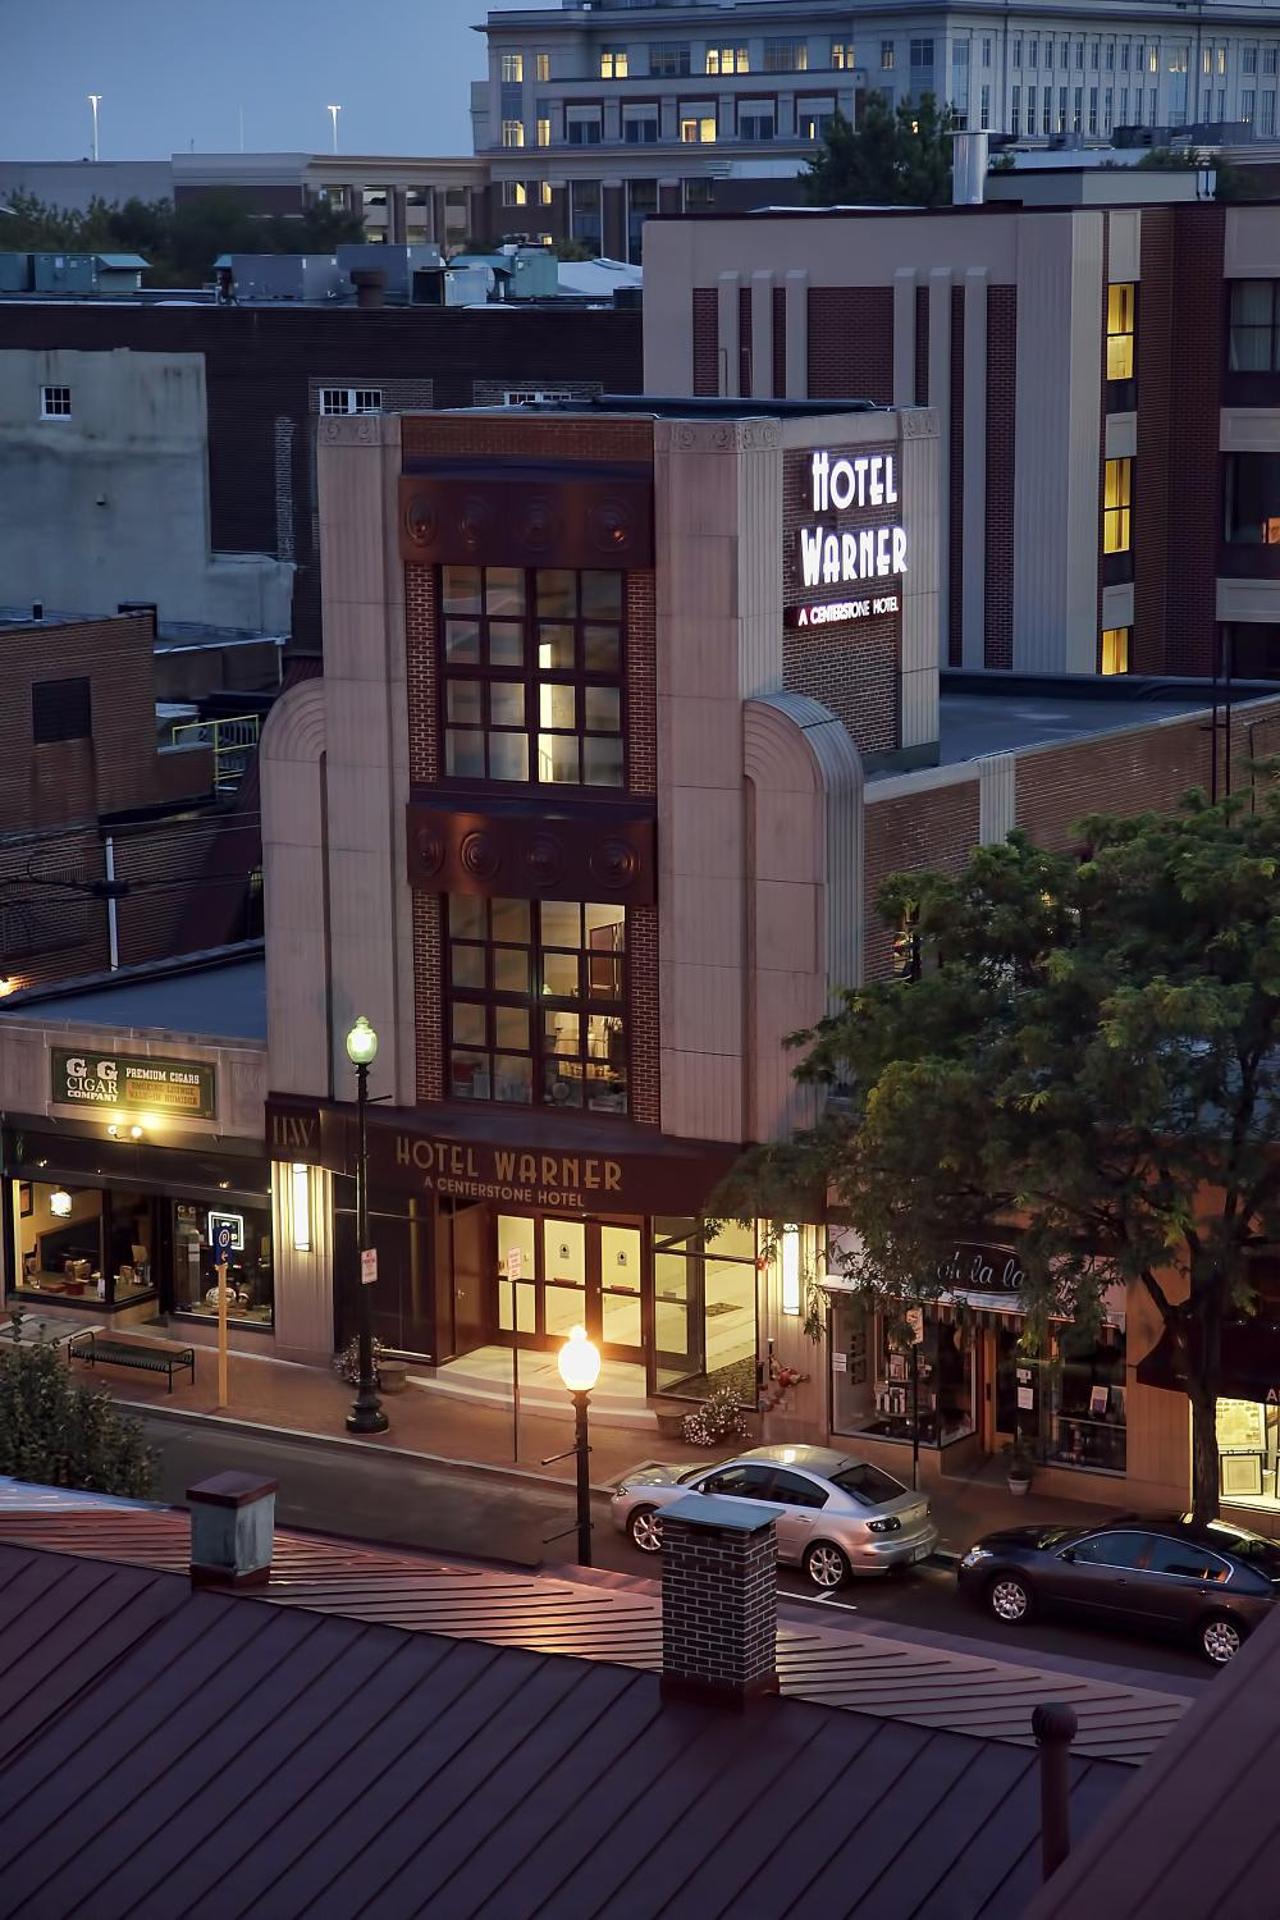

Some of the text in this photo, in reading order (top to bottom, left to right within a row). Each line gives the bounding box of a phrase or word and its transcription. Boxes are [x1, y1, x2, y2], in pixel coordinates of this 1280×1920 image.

[812, 451, 897, 512] HOTEL
[801, 526, 908, 587] WARNER
[798, 596, 899, 626] A CENTERSTONE HOTEL
[66, 1077, 119, 1094] CIGAR
[126, 1067, 200, 1085] PREMIUM CIGARS
[67, 1090, 118, 1102] COMPANY
[396, 1136, 622, 1191] HOTEL WARNER
[424, 1176, 584, 1208] A CENTERSTONE HOTEL
[970, 1255, 992, 1284] la
